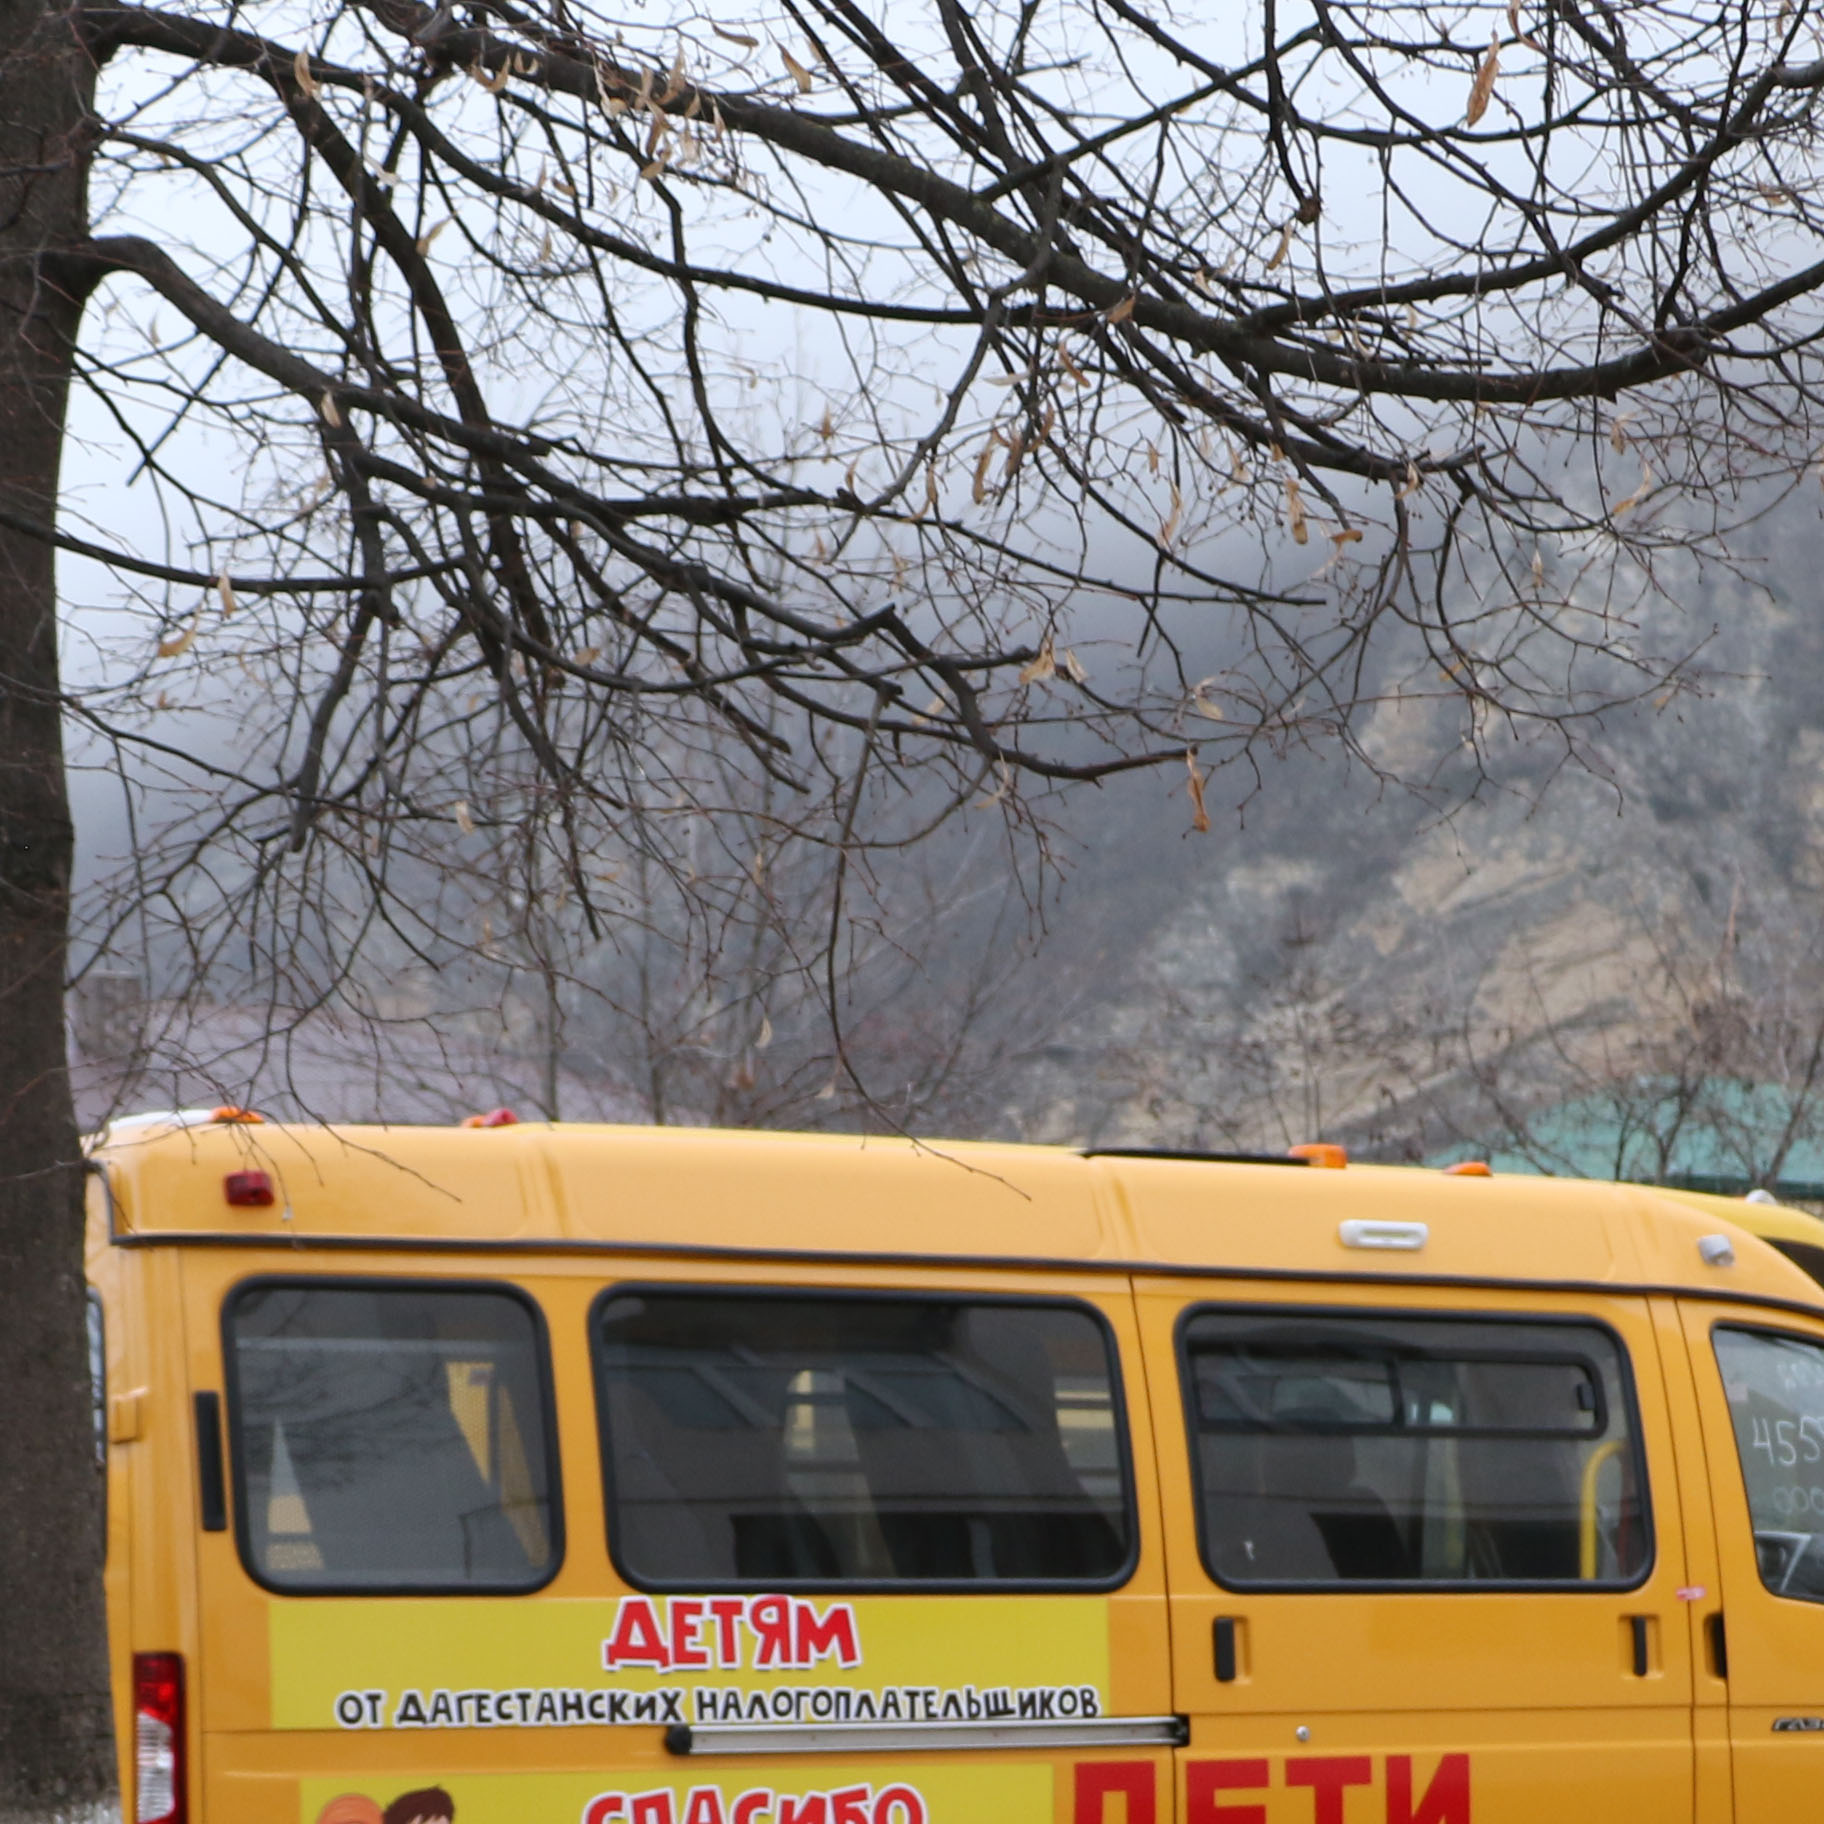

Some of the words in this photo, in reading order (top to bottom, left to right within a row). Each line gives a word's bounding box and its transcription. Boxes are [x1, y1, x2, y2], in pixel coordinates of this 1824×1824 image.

[603, 1594, 861, 1672] ДЕТЯМ
[338, 1692, 385, 1727] ОТ
[395, 1689, 683, 1726] ДАГЕСТАНСКИХ
[695, 1686, 1100, 1721] НАЛОГОПЛАТЕЛЬЩИКОВ
